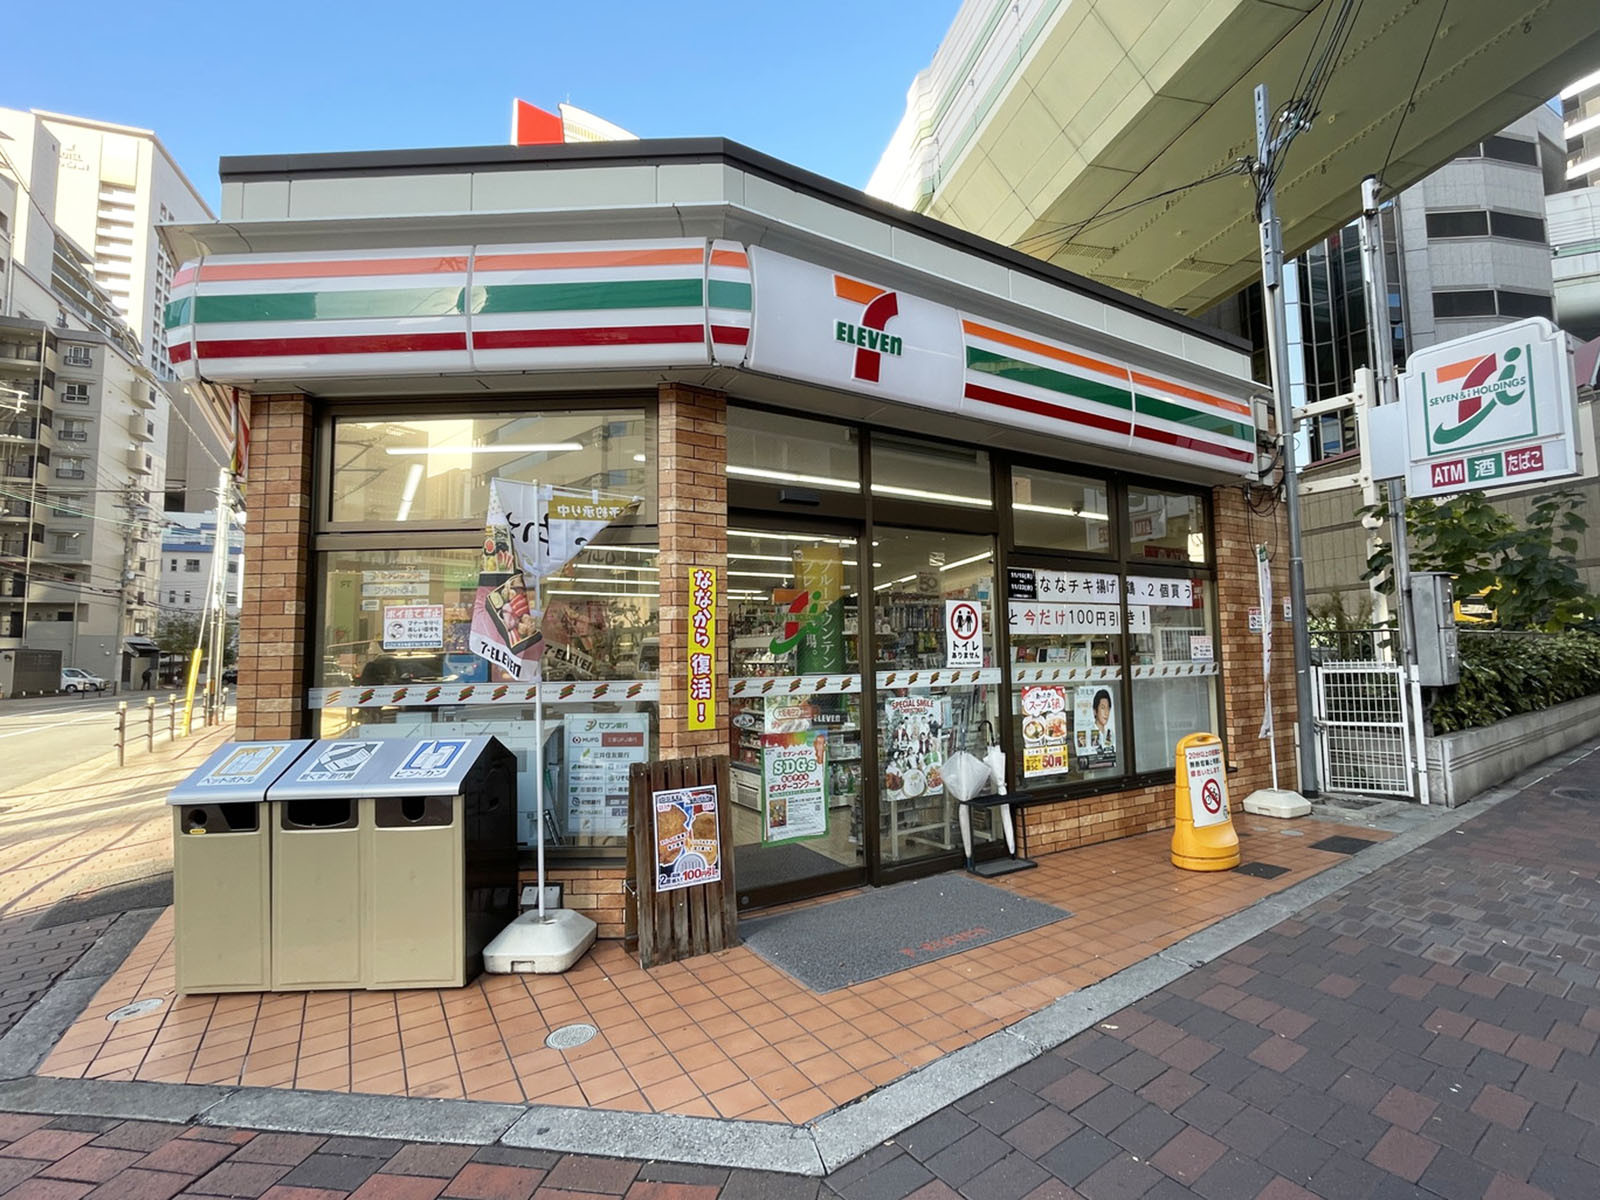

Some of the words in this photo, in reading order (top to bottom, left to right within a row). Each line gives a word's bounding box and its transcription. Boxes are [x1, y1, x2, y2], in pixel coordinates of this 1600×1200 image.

[1472, 376, 1527, 397] HOLDINGS
[1474, 459, 1496, 478] 酒
[1507, 449, 1543, 473] たばこ
[1434, 463, 1463, 484] ATM
[693, 569, 712, 647] ななから
[952, 641, 979, 651] トイレ
[891, 699, 916, 710] SPECIAL
[916, 698, 934, 708] SMILE
[773, 757, 817, 776] SDGs
[1042, 754, 1062, 768] 50円
